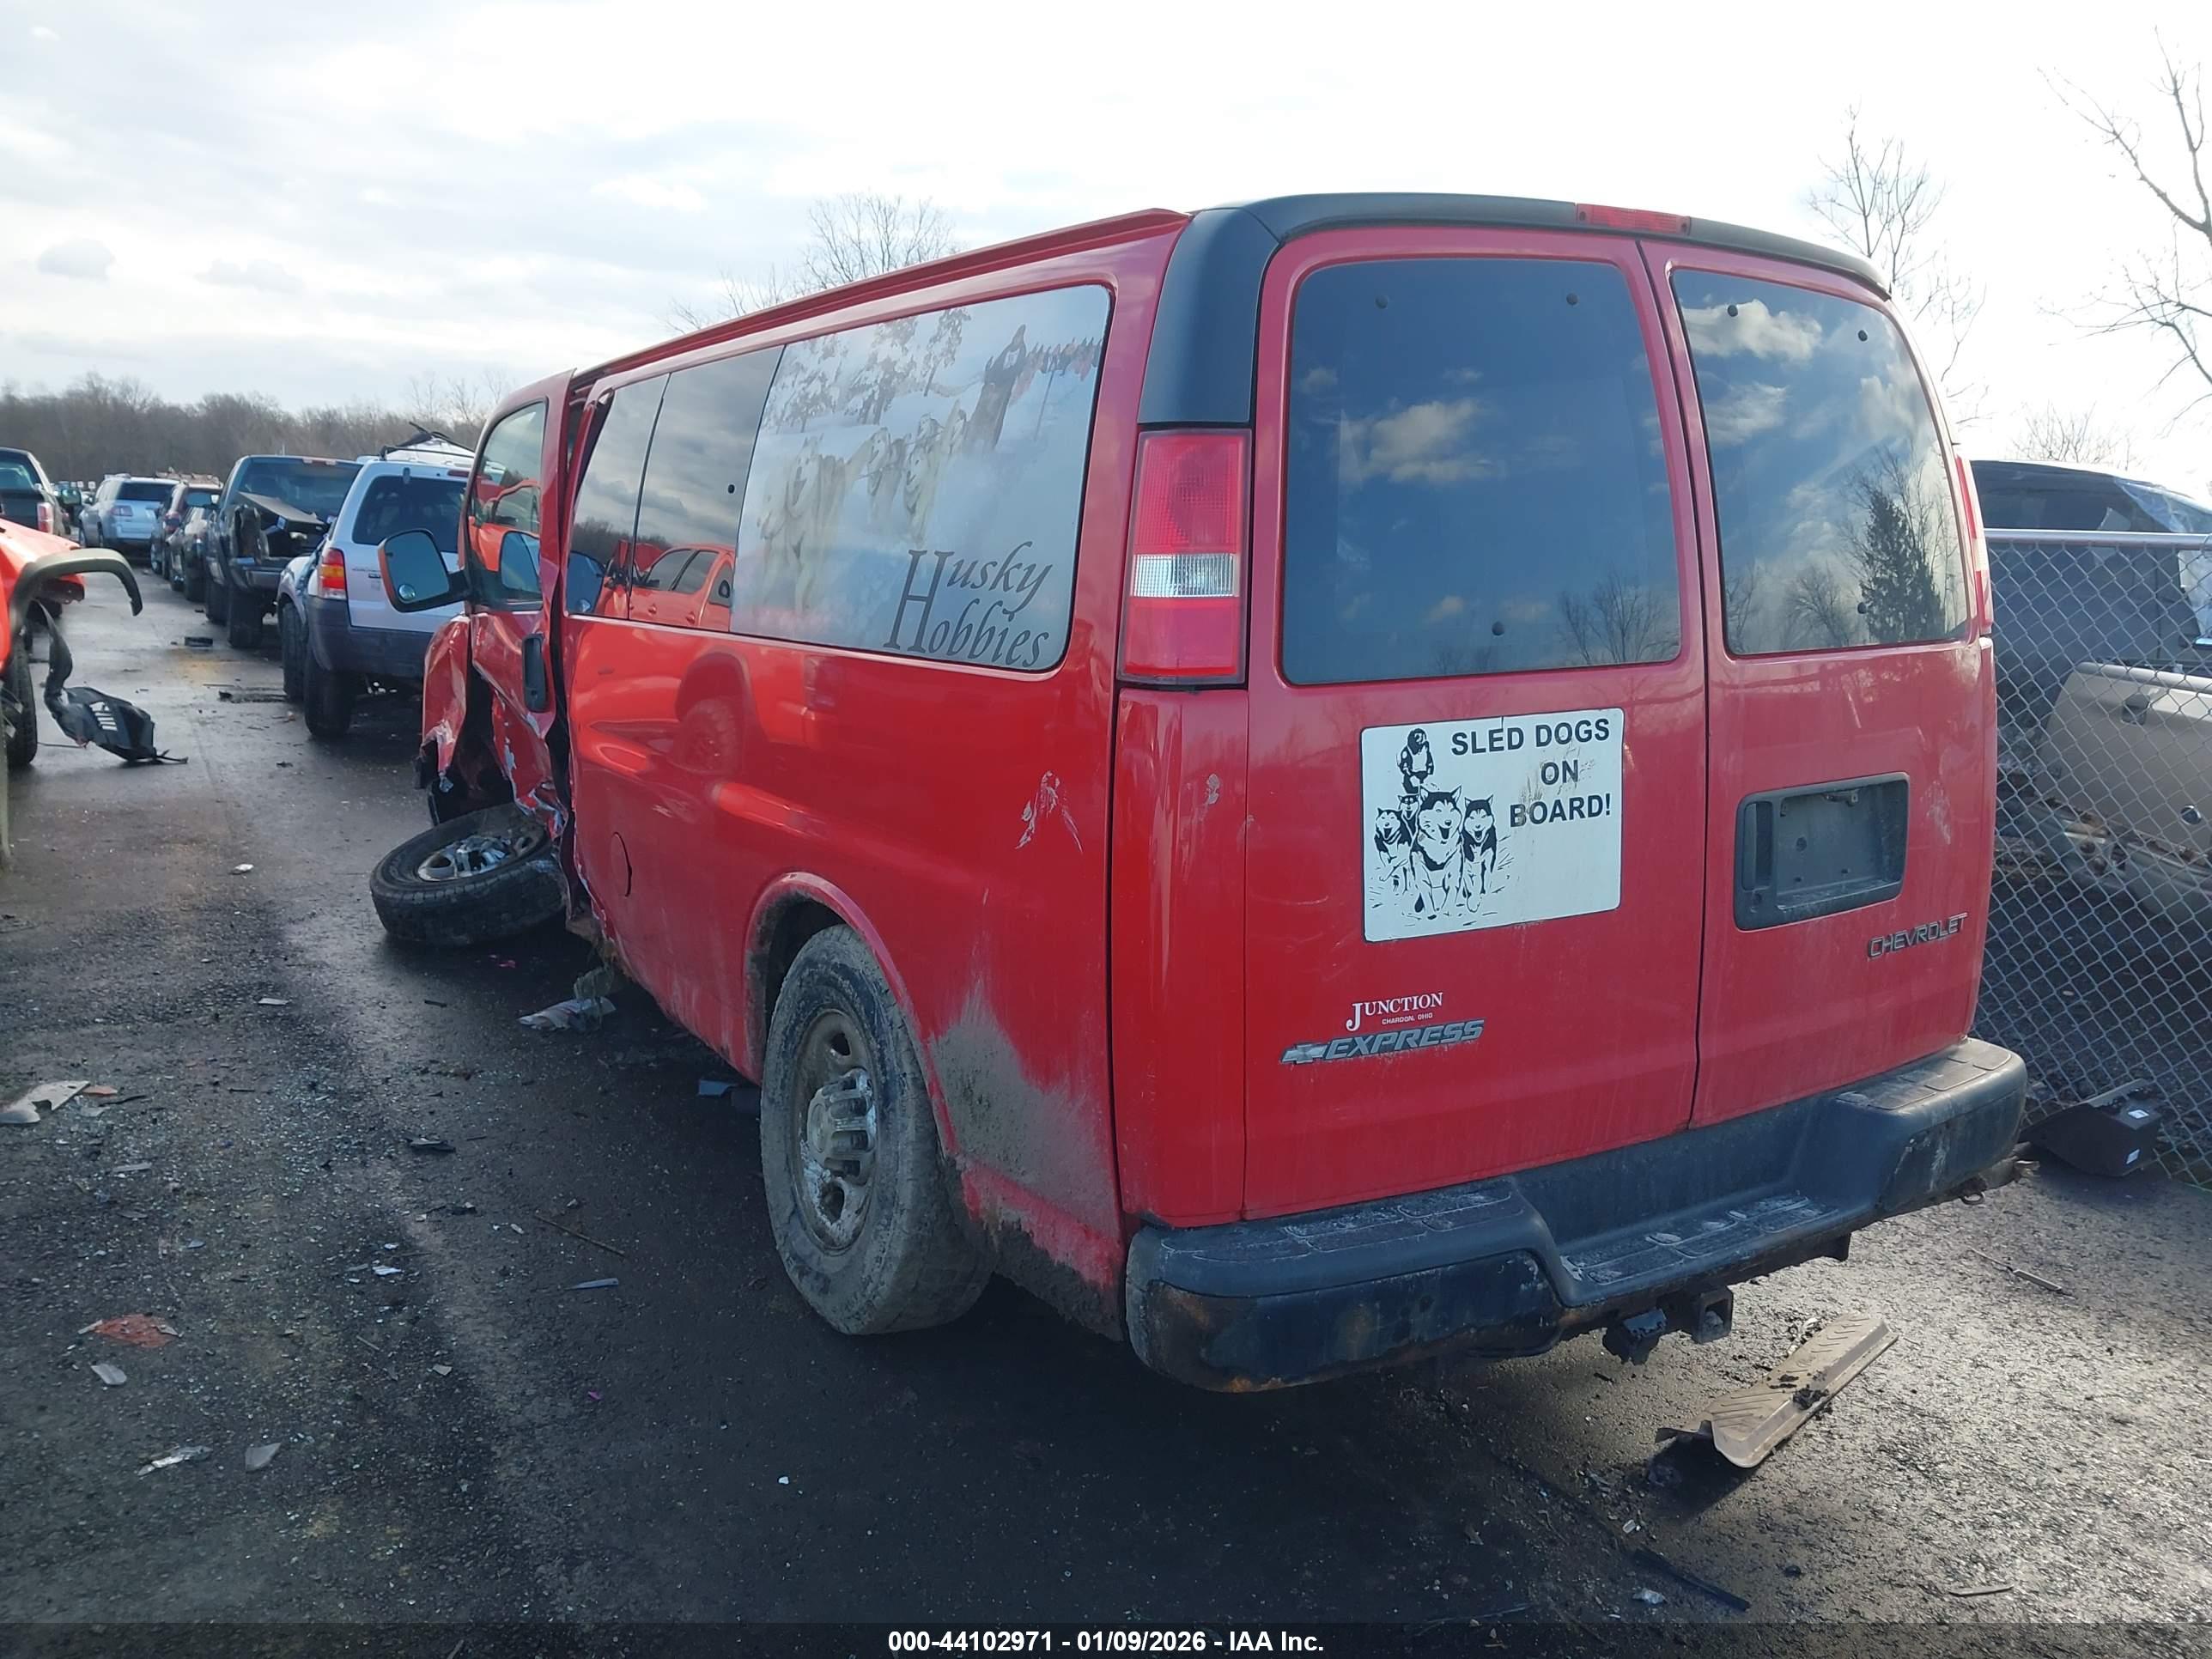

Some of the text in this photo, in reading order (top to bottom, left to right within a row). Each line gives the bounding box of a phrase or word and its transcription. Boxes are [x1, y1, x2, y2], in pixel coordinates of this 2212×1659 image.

[891, 541, 1053, 622] Husky
[883, 591, 1049, 667] Hobbies
[1451, 718, 1610, 756] SLED DOGS
[1540, 758, 1579, 786] ON
[1510, 793, 1611, 828] BOARD!
[1867, 912, 1968, 958] CHEVROLET
[1346, 992, 1443, 1031] JUNCTION
[1417, 1012, 1433, 1021] OHIO
[1324, 1019, 1485, 1060] EXPRESS
